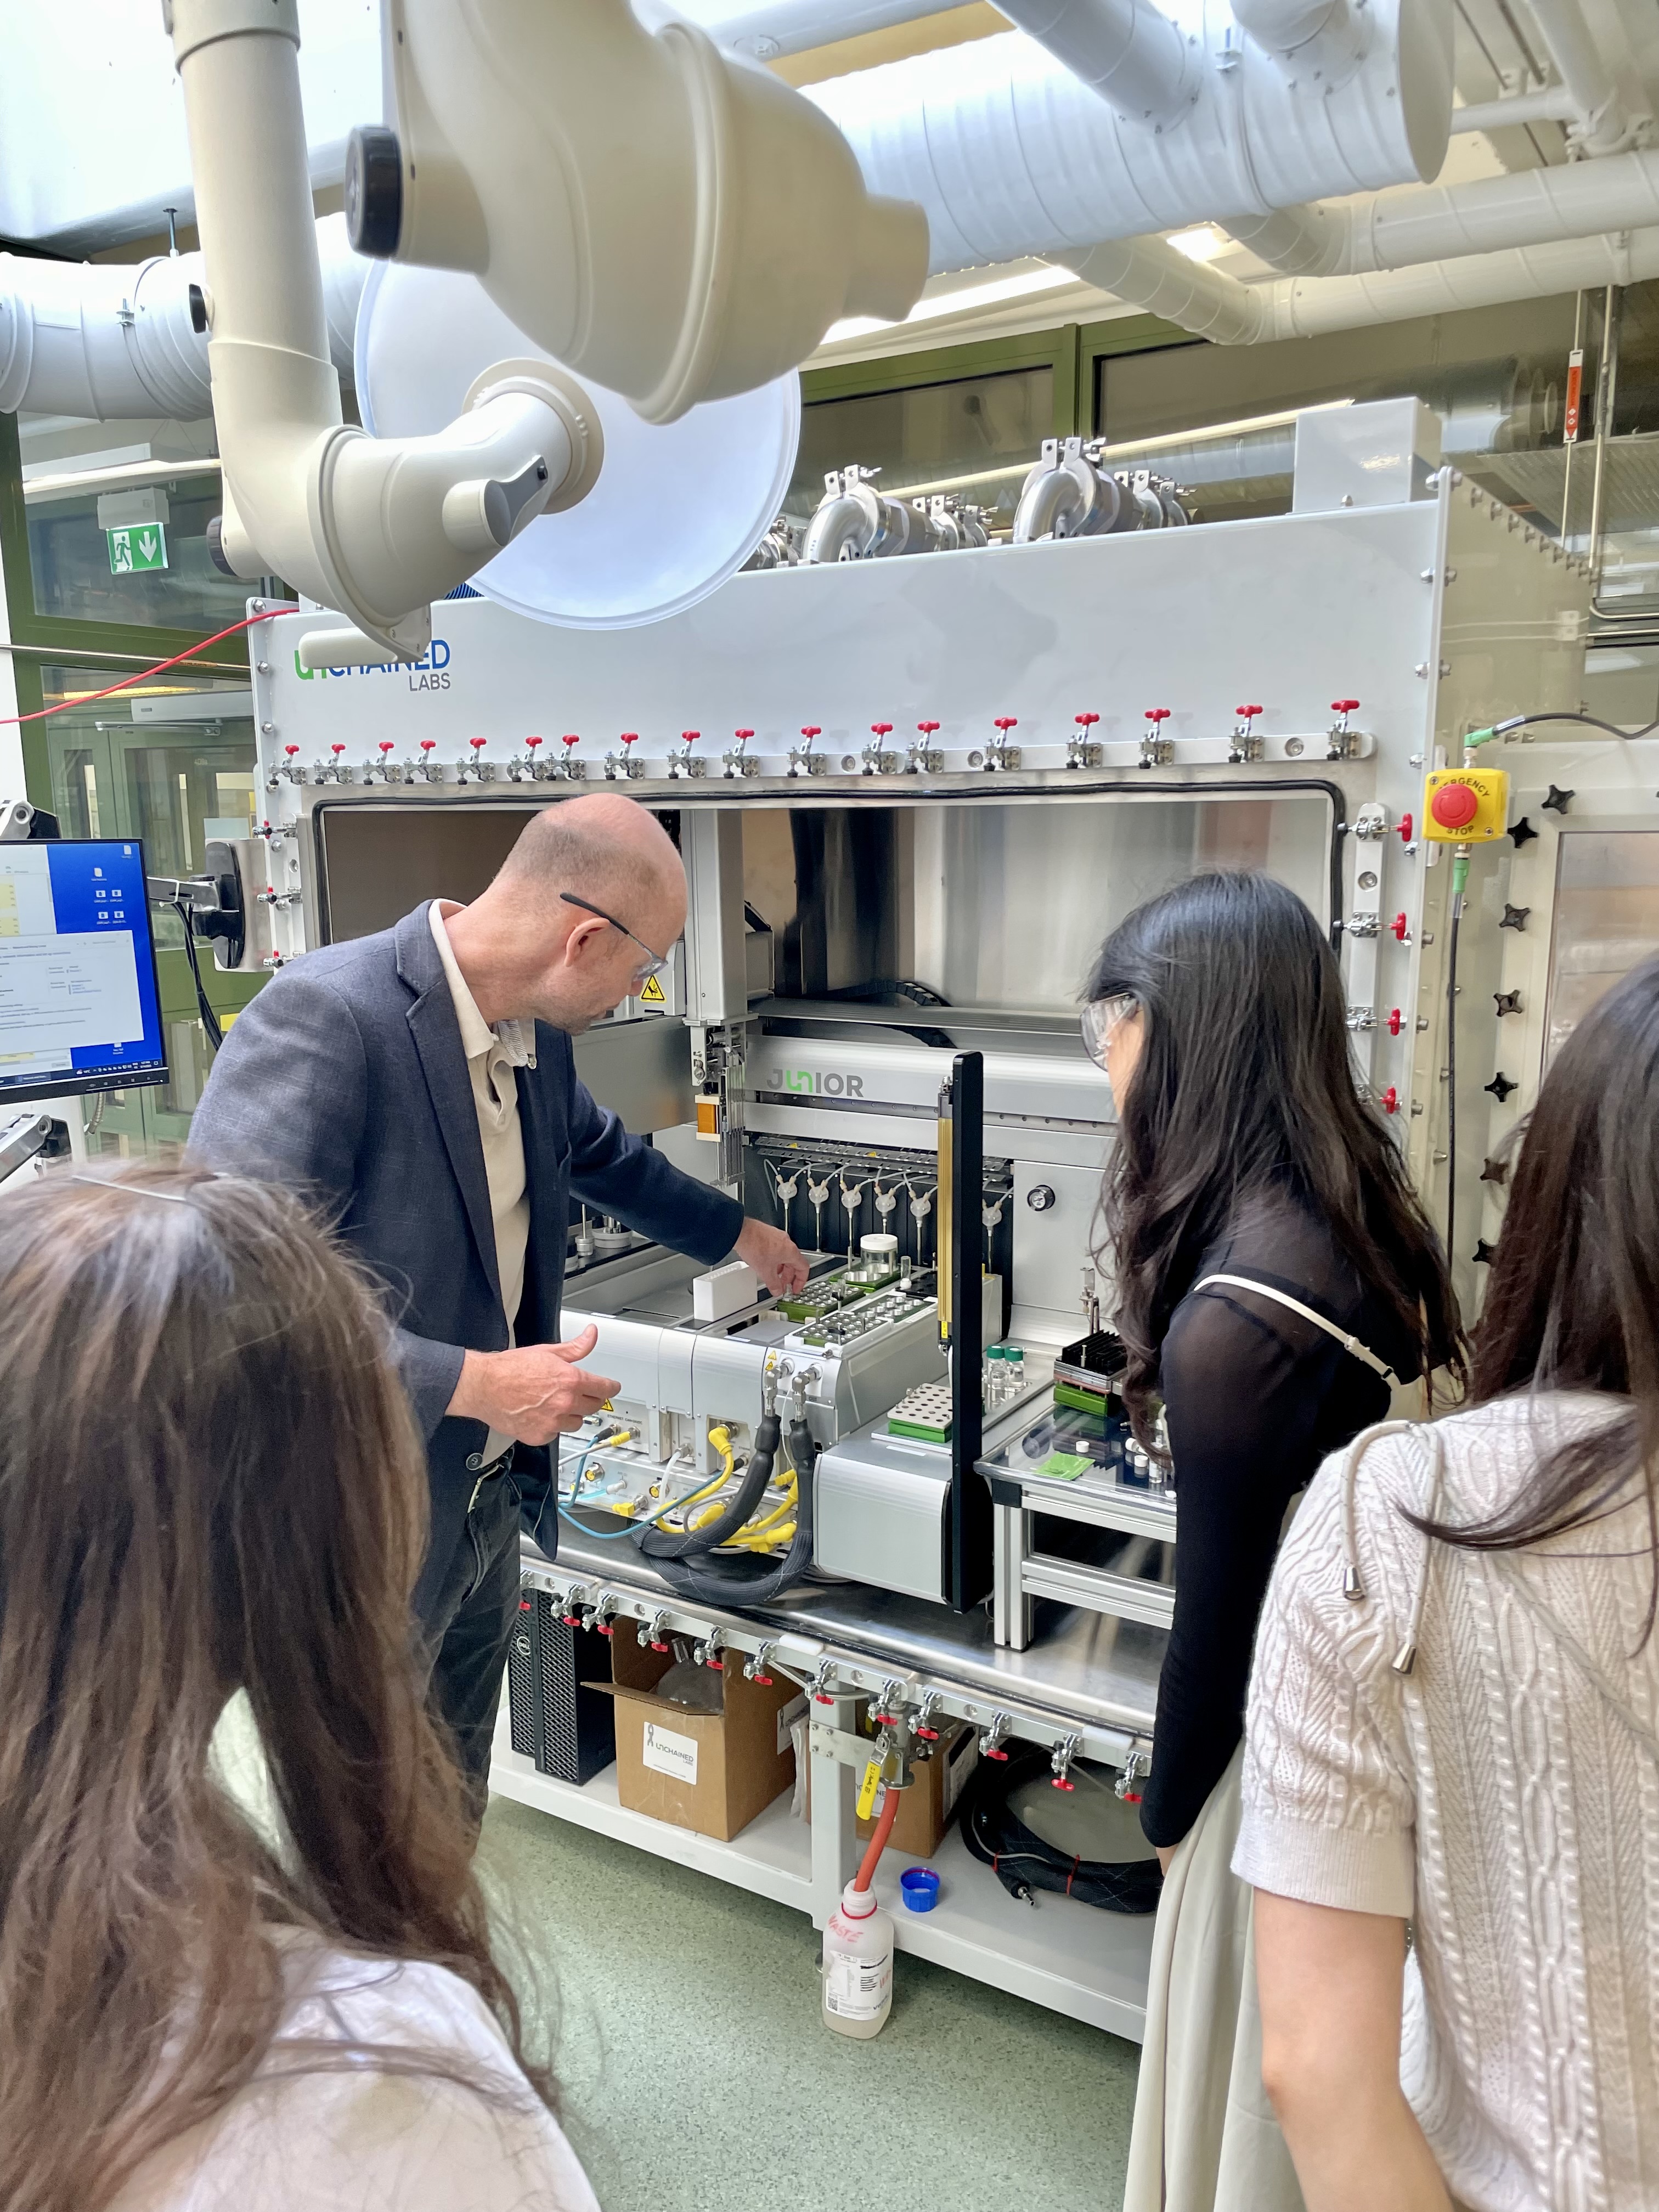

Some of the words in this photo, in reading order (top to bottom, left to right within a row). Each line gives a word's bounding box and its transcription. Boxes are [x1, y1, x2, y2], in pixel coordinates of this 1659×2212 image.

[409, 673, 450, 691] LABS
[1440, 777, 1490, 797] RGENCY
[1446, 825, 1474, 835] STOP
[766, 1068, 864, 1098] JUNIOR
[656, 1742, 693, 1762] UNCHAINED
[828, 1914, 864, 1943] WASTE
